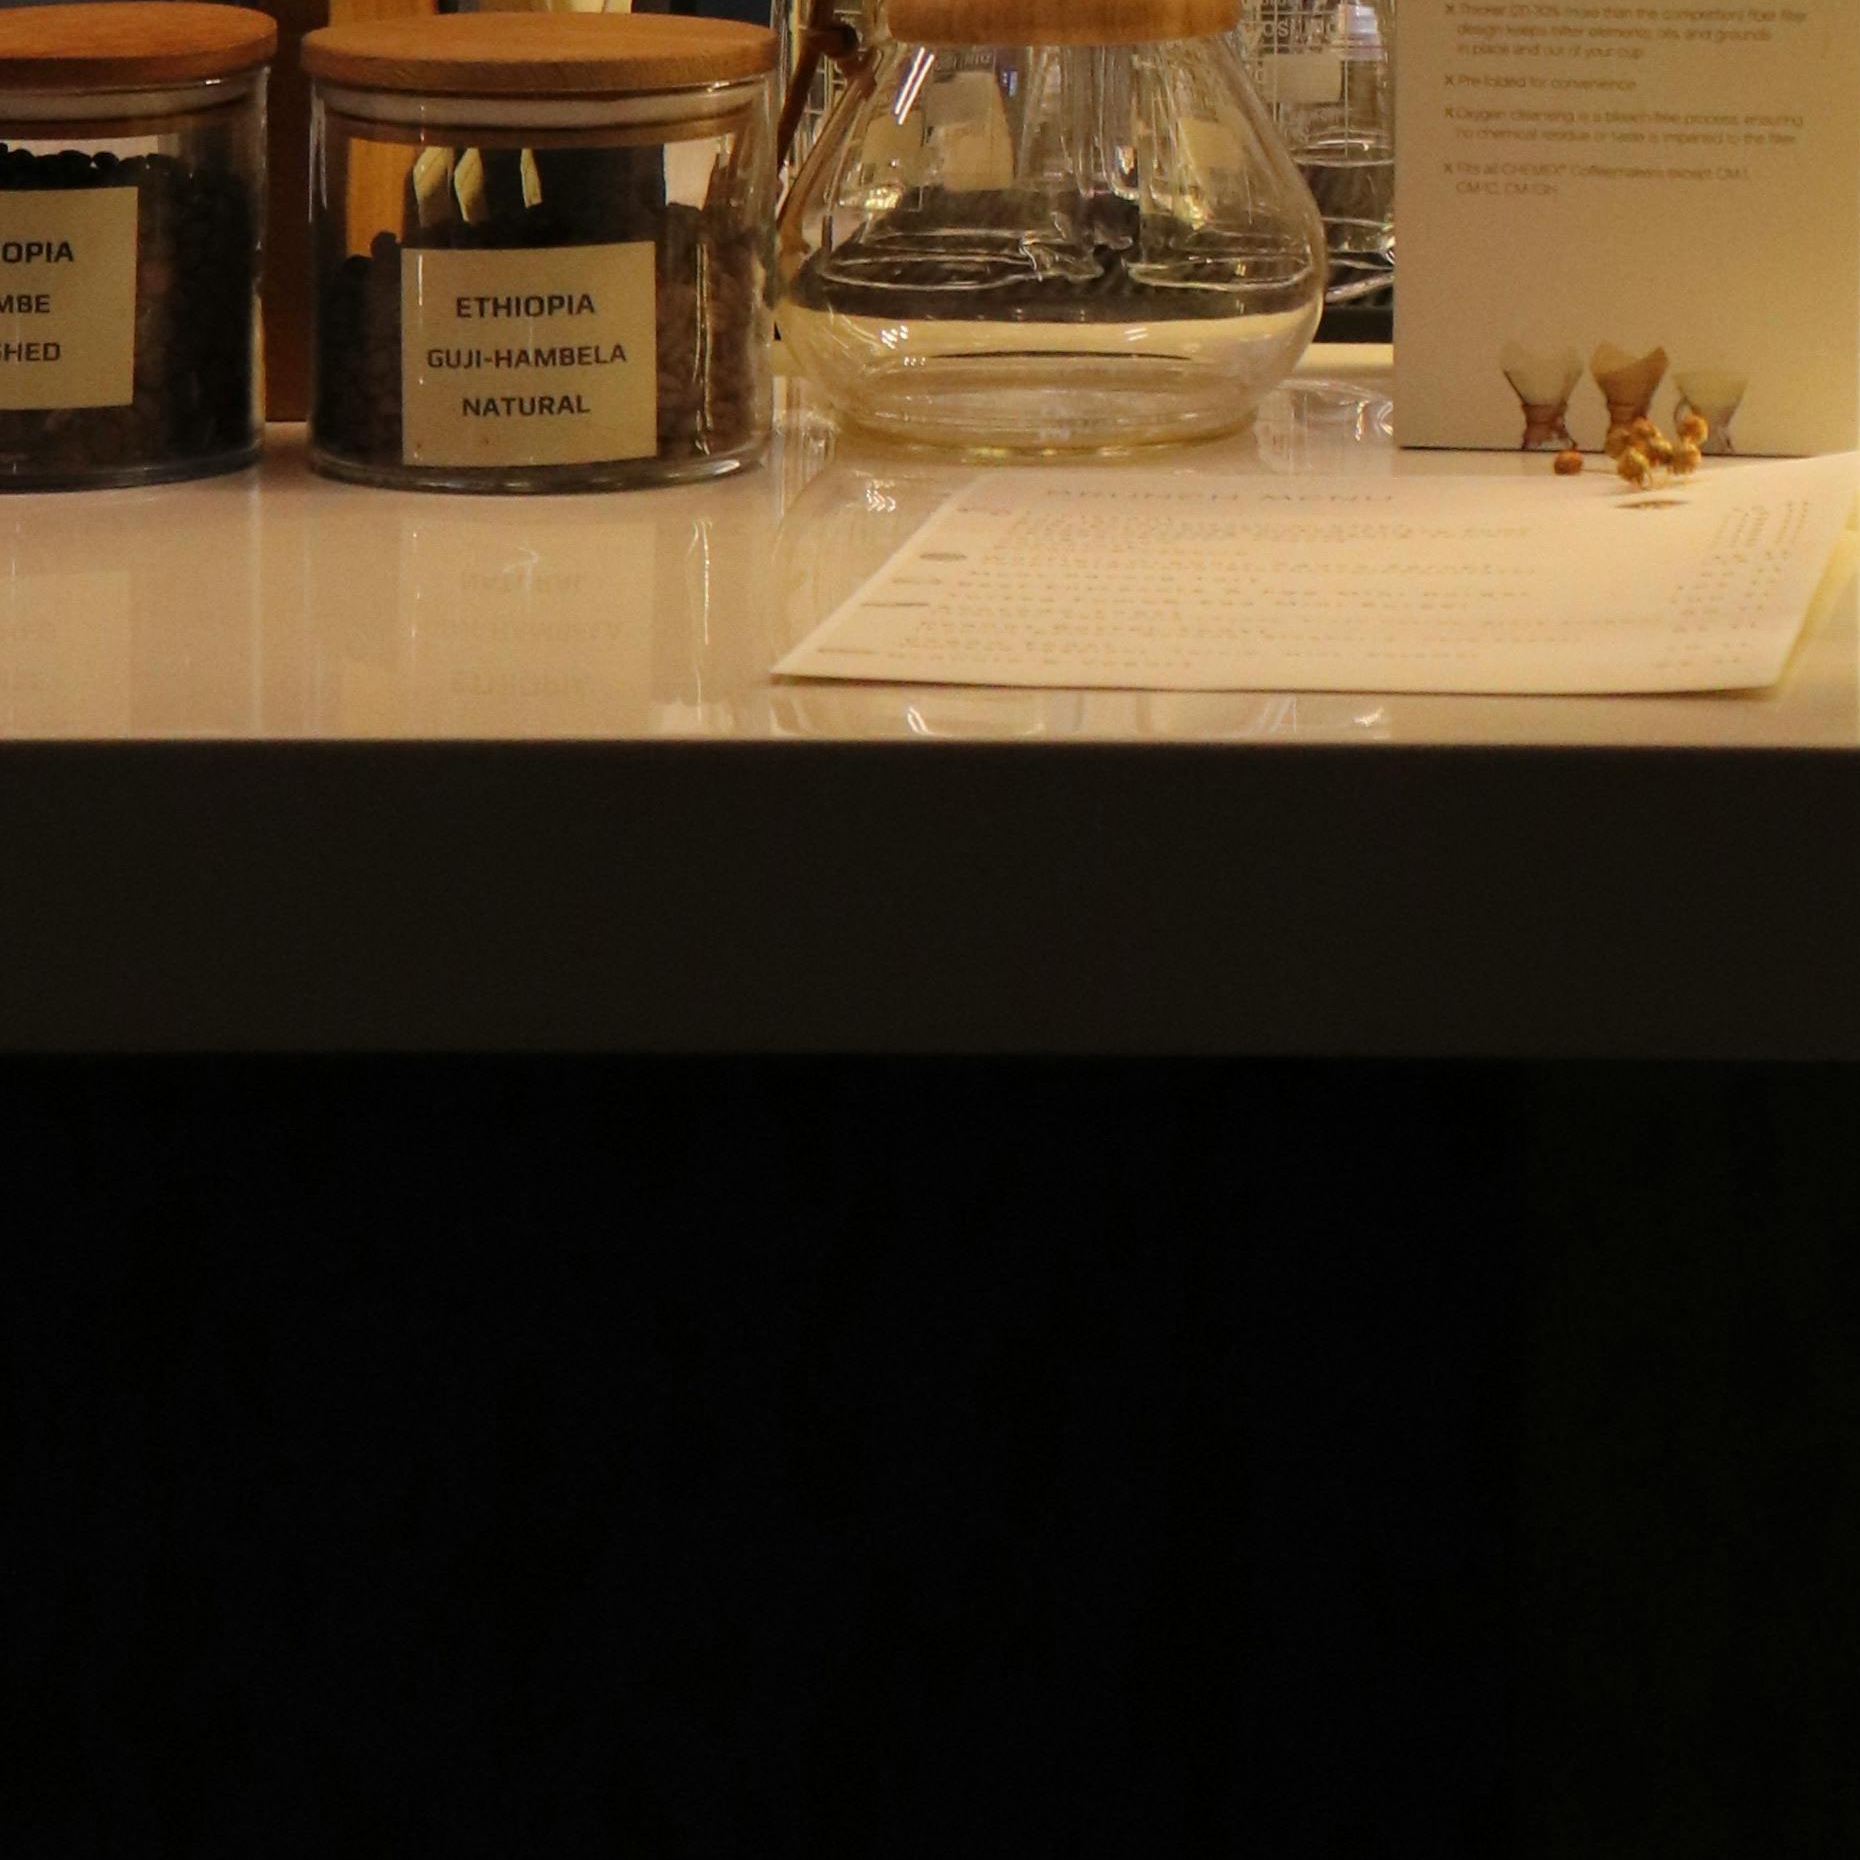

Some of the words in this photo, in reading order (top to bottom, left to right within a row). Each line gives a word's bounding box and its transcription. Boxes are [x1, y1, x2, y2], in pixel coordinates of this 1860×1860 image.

[453, 291, 597, 321] ETHIOPIA
[425, 341, 629, 373] GUJI-HAMBELA
[460, 392, 592, 421] NATURAL
